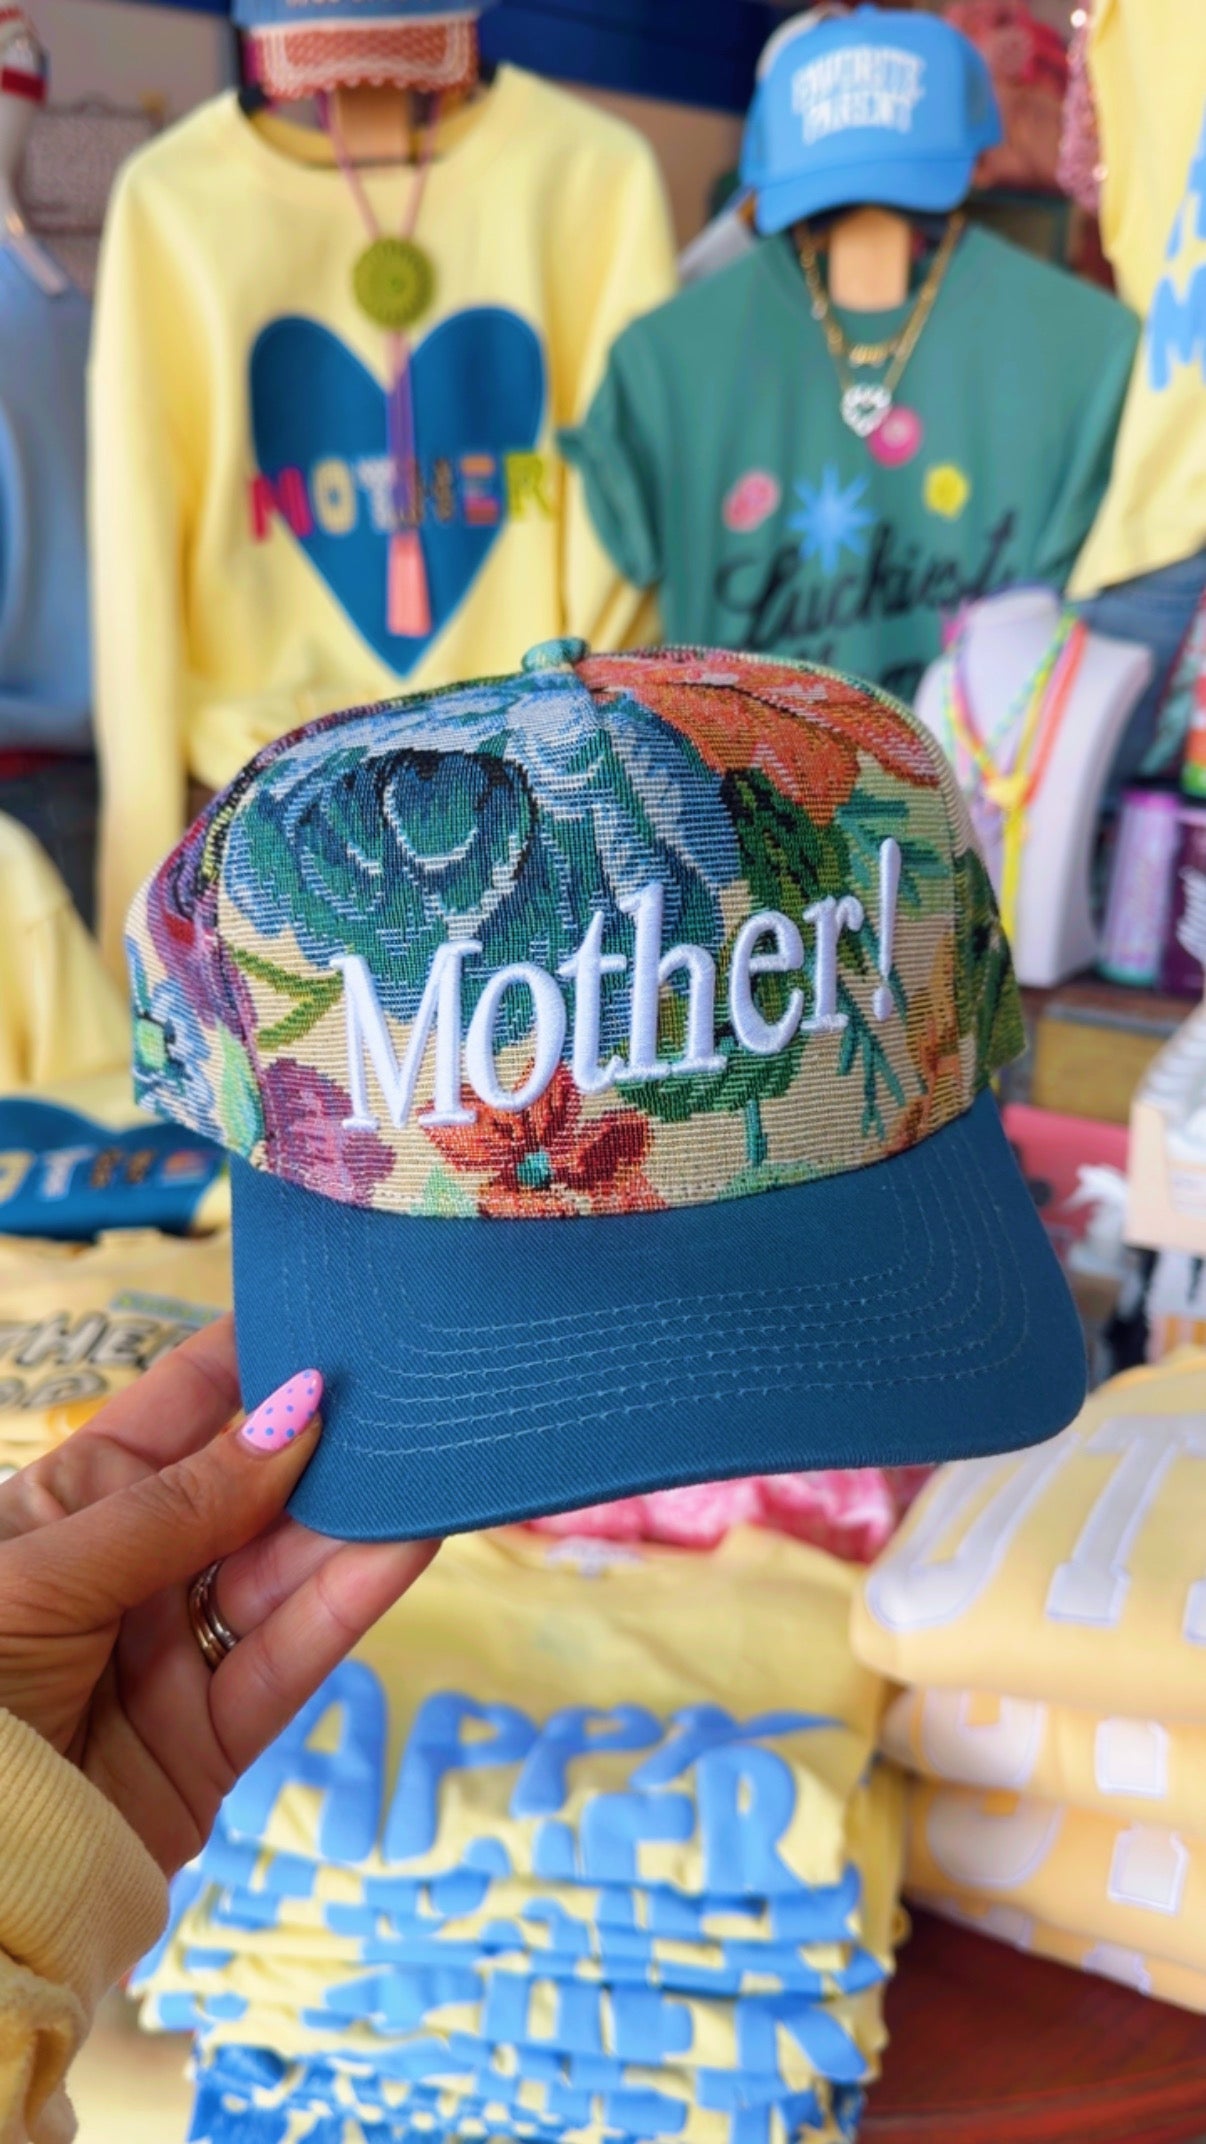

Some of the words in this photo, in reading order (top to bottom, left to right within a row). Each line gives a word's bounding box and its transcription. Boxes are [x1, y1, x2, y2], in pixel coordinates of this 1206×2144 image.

[803, 88, 914, 145] PARENT
[248, 450, 558, 544] MOTHER
[331, 838, 900, 1132] Mother!
